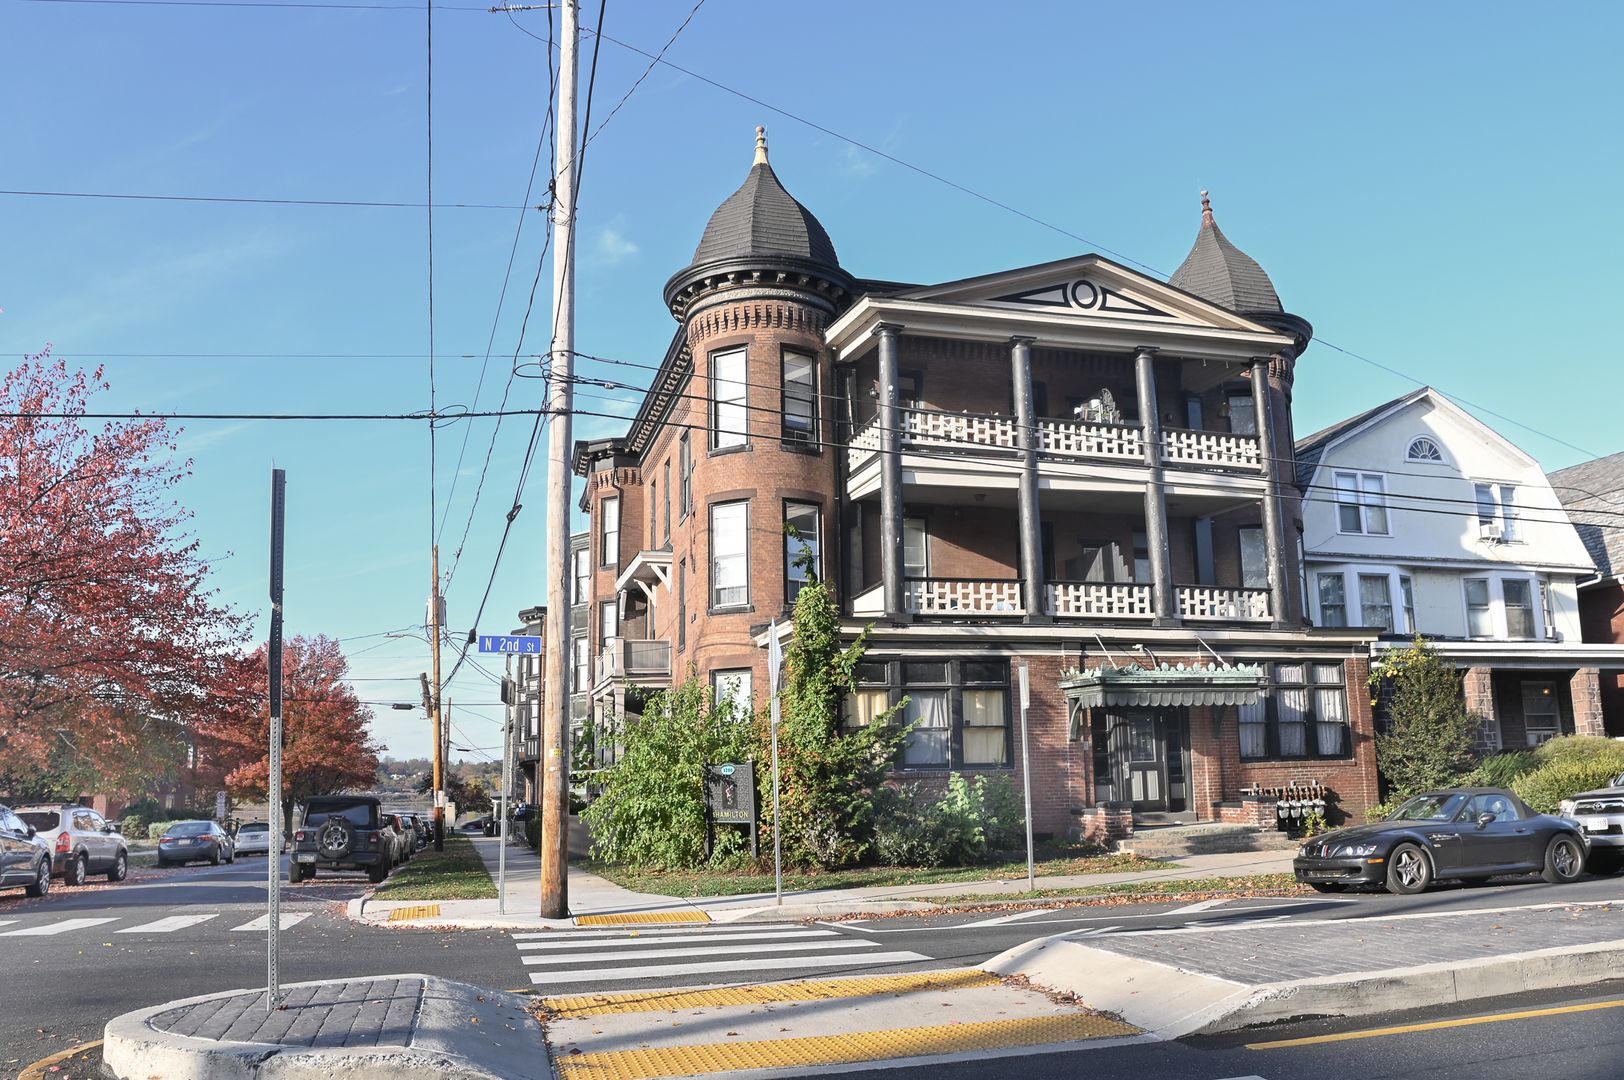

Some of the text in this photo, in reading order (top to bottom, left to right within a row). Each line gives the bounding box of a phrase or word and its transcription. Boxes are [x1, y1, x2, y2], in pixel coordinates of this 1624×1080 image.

[485, 637, 535, 652] N 2nd St
